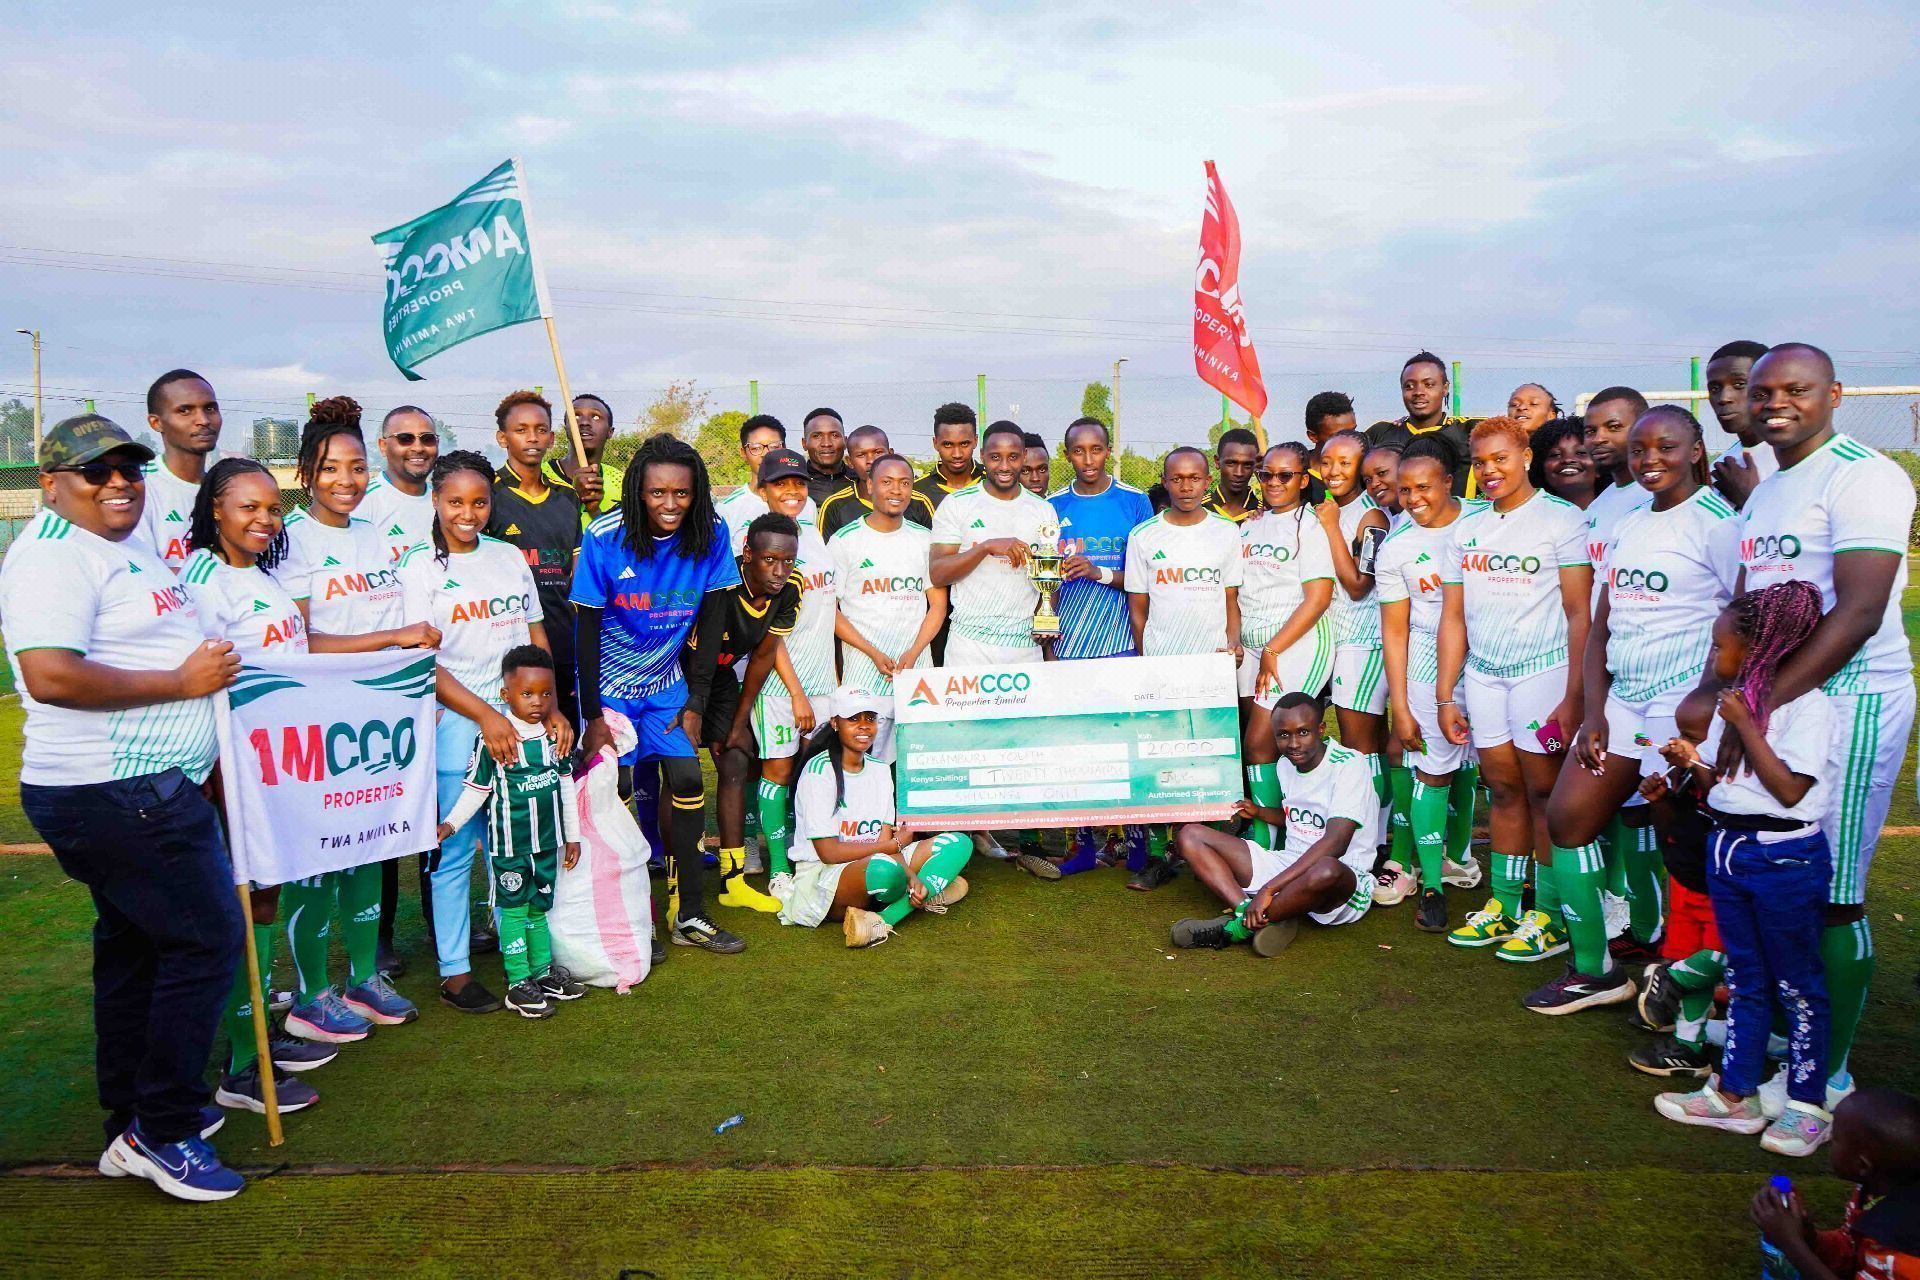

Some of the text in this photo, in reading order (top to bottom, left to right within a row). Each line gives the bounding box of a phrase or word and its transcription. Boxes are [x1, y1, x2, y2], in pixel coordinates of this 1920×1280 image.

[1242, 543, 1290, 563] MCCO
[1741, 534, 1802, 562] MCCO
[1461, 554, 1540, 574] AMCCO
[801, 571, 836, 592] AMC
[861, 576, 924, 595] AMCCO
[1607, 567, 1669, 593] MCCO
[451, 593, 531, 625] AMCCO
[490, 616, 528, 629] PROPERTIE
[945, 672, 1031, 696] AMCCO
[944, 695, 1028, 711] Properties Limited
[1134, 692, 1155, 701] DATE
[910, 743, 925, 752] Pay
[517, 779, 553, 793] Viewer
[523, 773, 551, 785] Team
[910, 774, 968, 785] Kenya Shillings
[323, 781, 405, 810] PROPERTIES
[1148, 790, 1190, 799] Authorised
[1284, 805, 1326, 830] CCO
[840, 819, 883, 838] MCC
[319, 837, 352, 850] TWA
